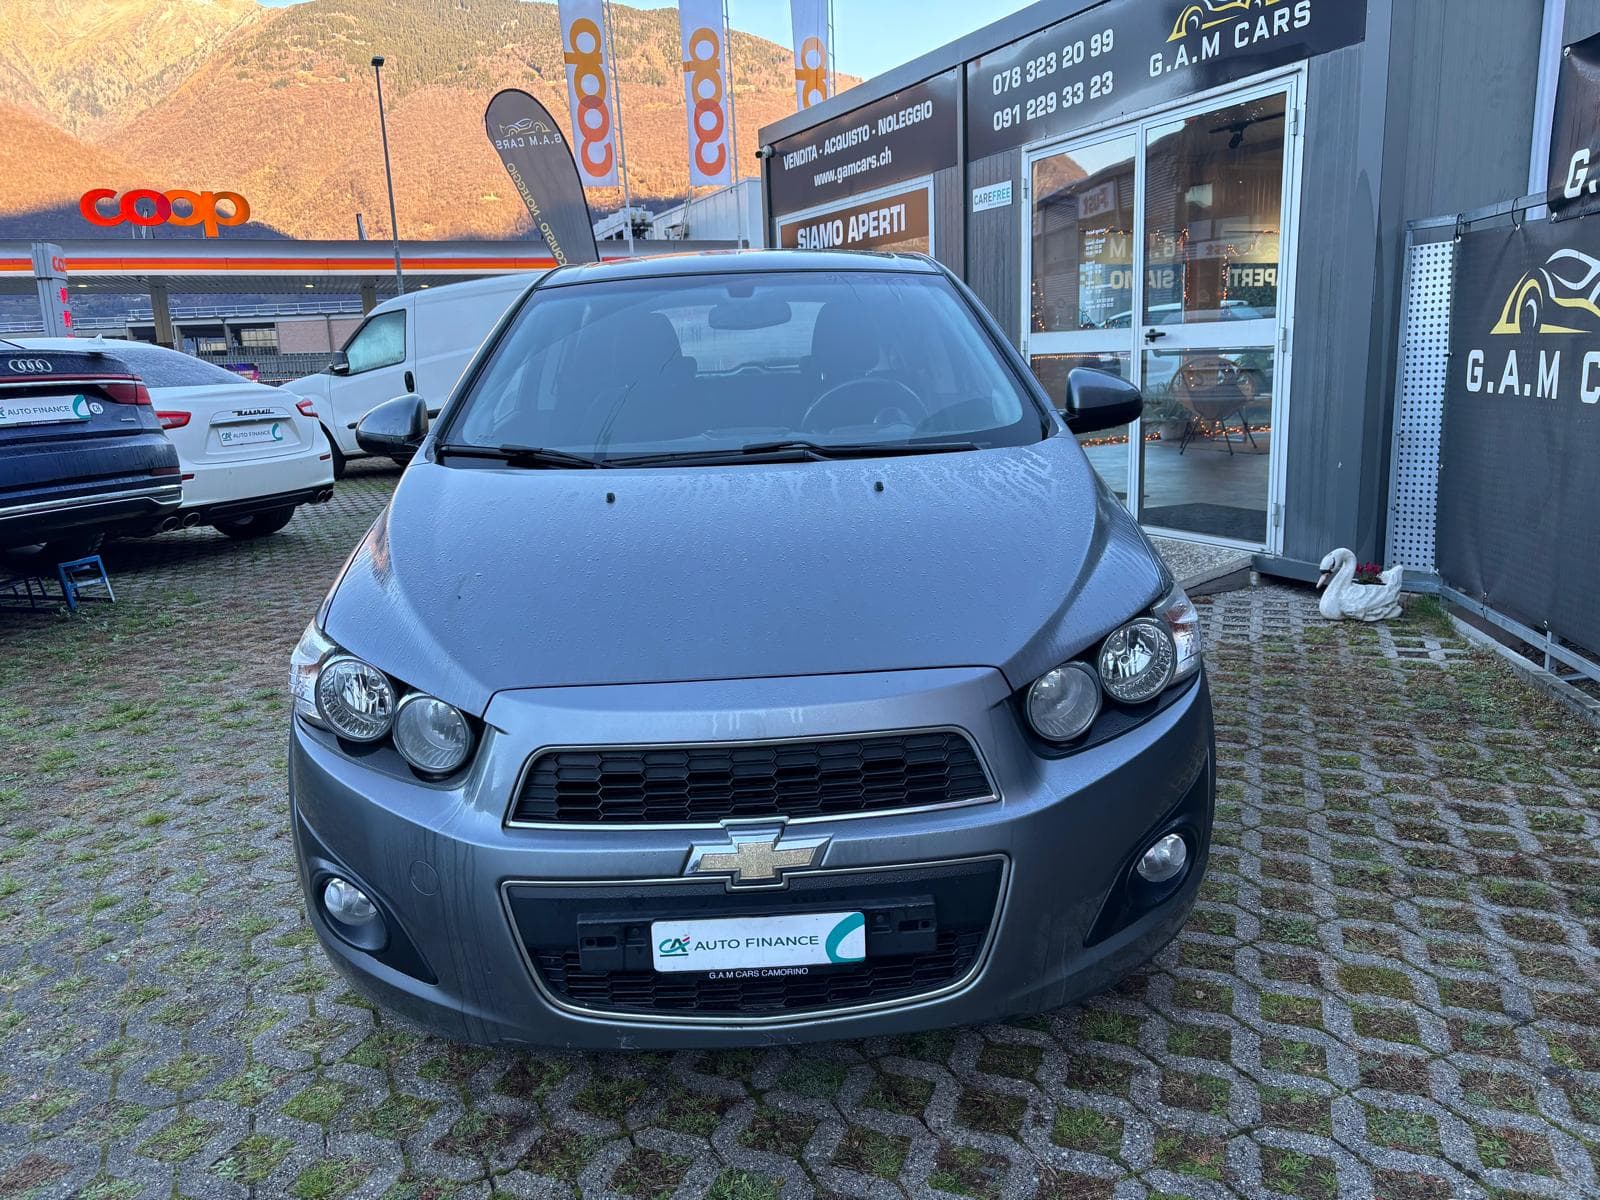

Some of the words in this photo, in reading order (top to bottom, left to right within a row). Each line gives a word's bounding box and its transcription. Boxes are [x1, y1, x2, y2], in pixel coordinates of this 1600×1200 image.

[992, 66, 1021, 96] 078
[1026, 52, 1057, 83] 323
[1062, 40, 1085, 69] 20
[1090, 28, 1114, 57] 99
[1149, 31, 1220, 78] G.A.M
[1234, 0, 1311, 49] CARS
[993, 104, 1020, 132] 091
[1026, 91, 1057, 121] 229
[1062, 82, 1084, 108] 33
[1089, 70, 1113, 99] 23
[783, 144, 818, 171] VENDITA
[824, 124, 870, 156] ACQUISTO
[878, 99, 933, 137] NOLEGGIO
[813, 146, 892, 187] www.gamcars.ch
[80, 188, 251, 238] coop
[974, 187, 1011, 206] CAREFREE
[797, 219, 843, 249] SIAMO
[847, 204, 906, 243] APERTI
[1466, 349, 1560, 399] G.A.M
[7, 407, 32, 416] AUTO
[33, 405, 71, 414] FINANCE
[694, 939, 741, 951] AUTO
[745, 935, 820, 948] FINANCE
[708, 970, 734, 979] G.A.M
[735, 969, 760, 978] CARS
[761, 967, 809, 977] CAMORINO
